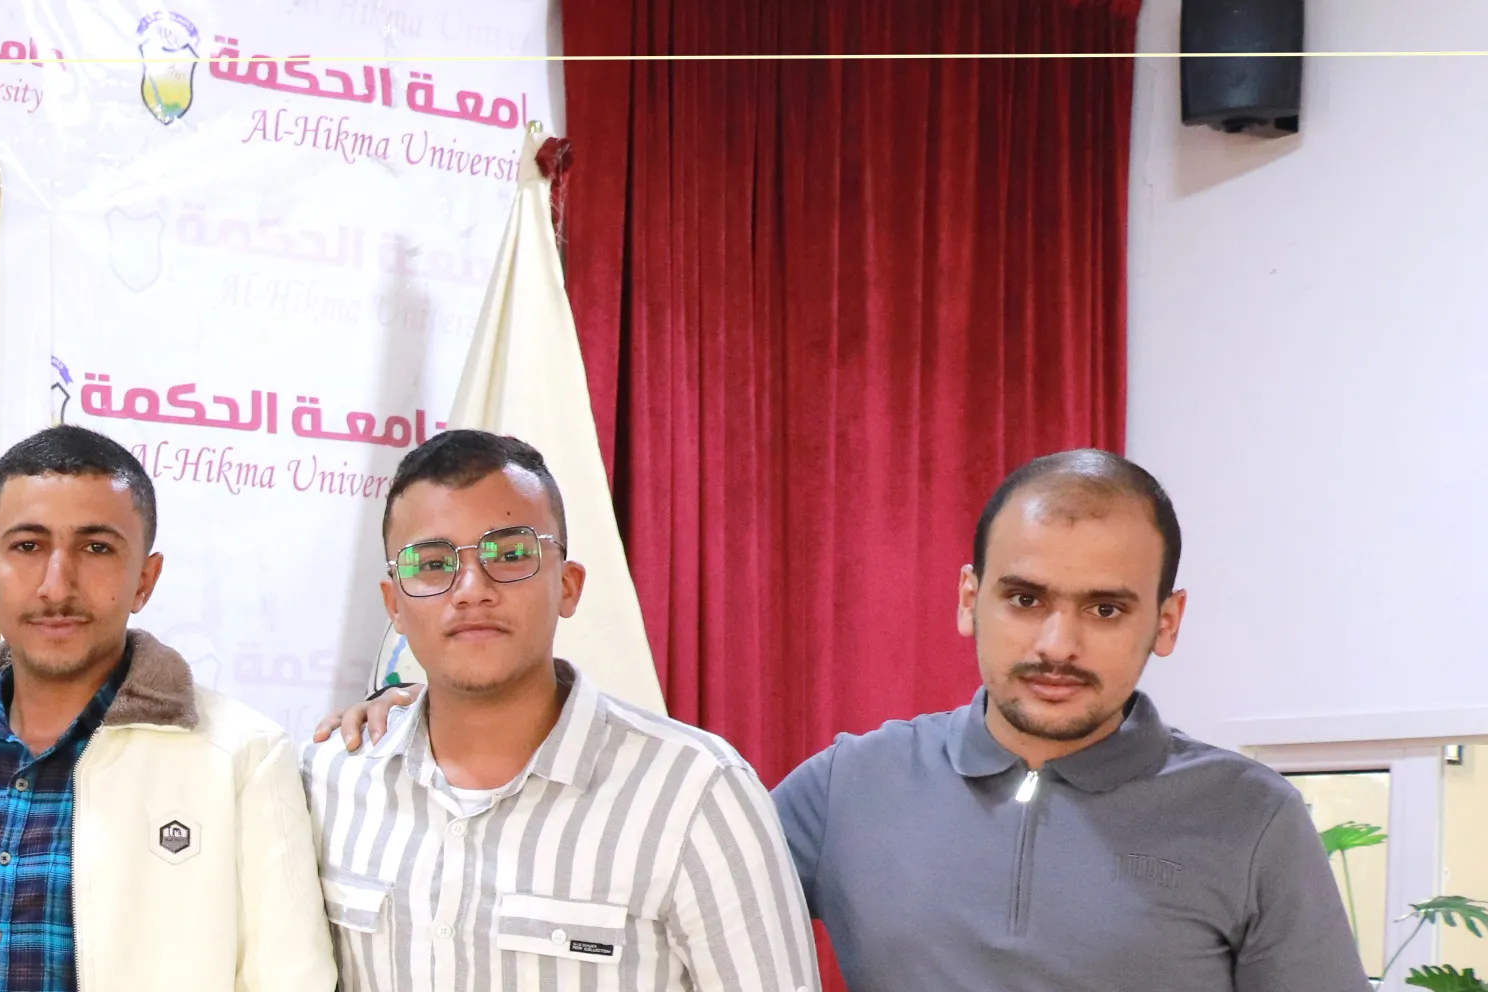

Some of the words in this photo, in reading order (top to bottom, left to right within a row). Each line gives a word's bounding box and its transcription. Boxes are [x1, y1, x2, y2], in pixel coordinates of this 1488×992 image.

[210, 35, 393, 108] الحكمة
[407, 71, 528, 130] امعة
[241, 108, 391, 165] Al-Hikma
[81, 372, 279, 435] الحكمة
[291, 395, 447, 449] امعة
[131, 441, 276, 496] Al-Hikma
